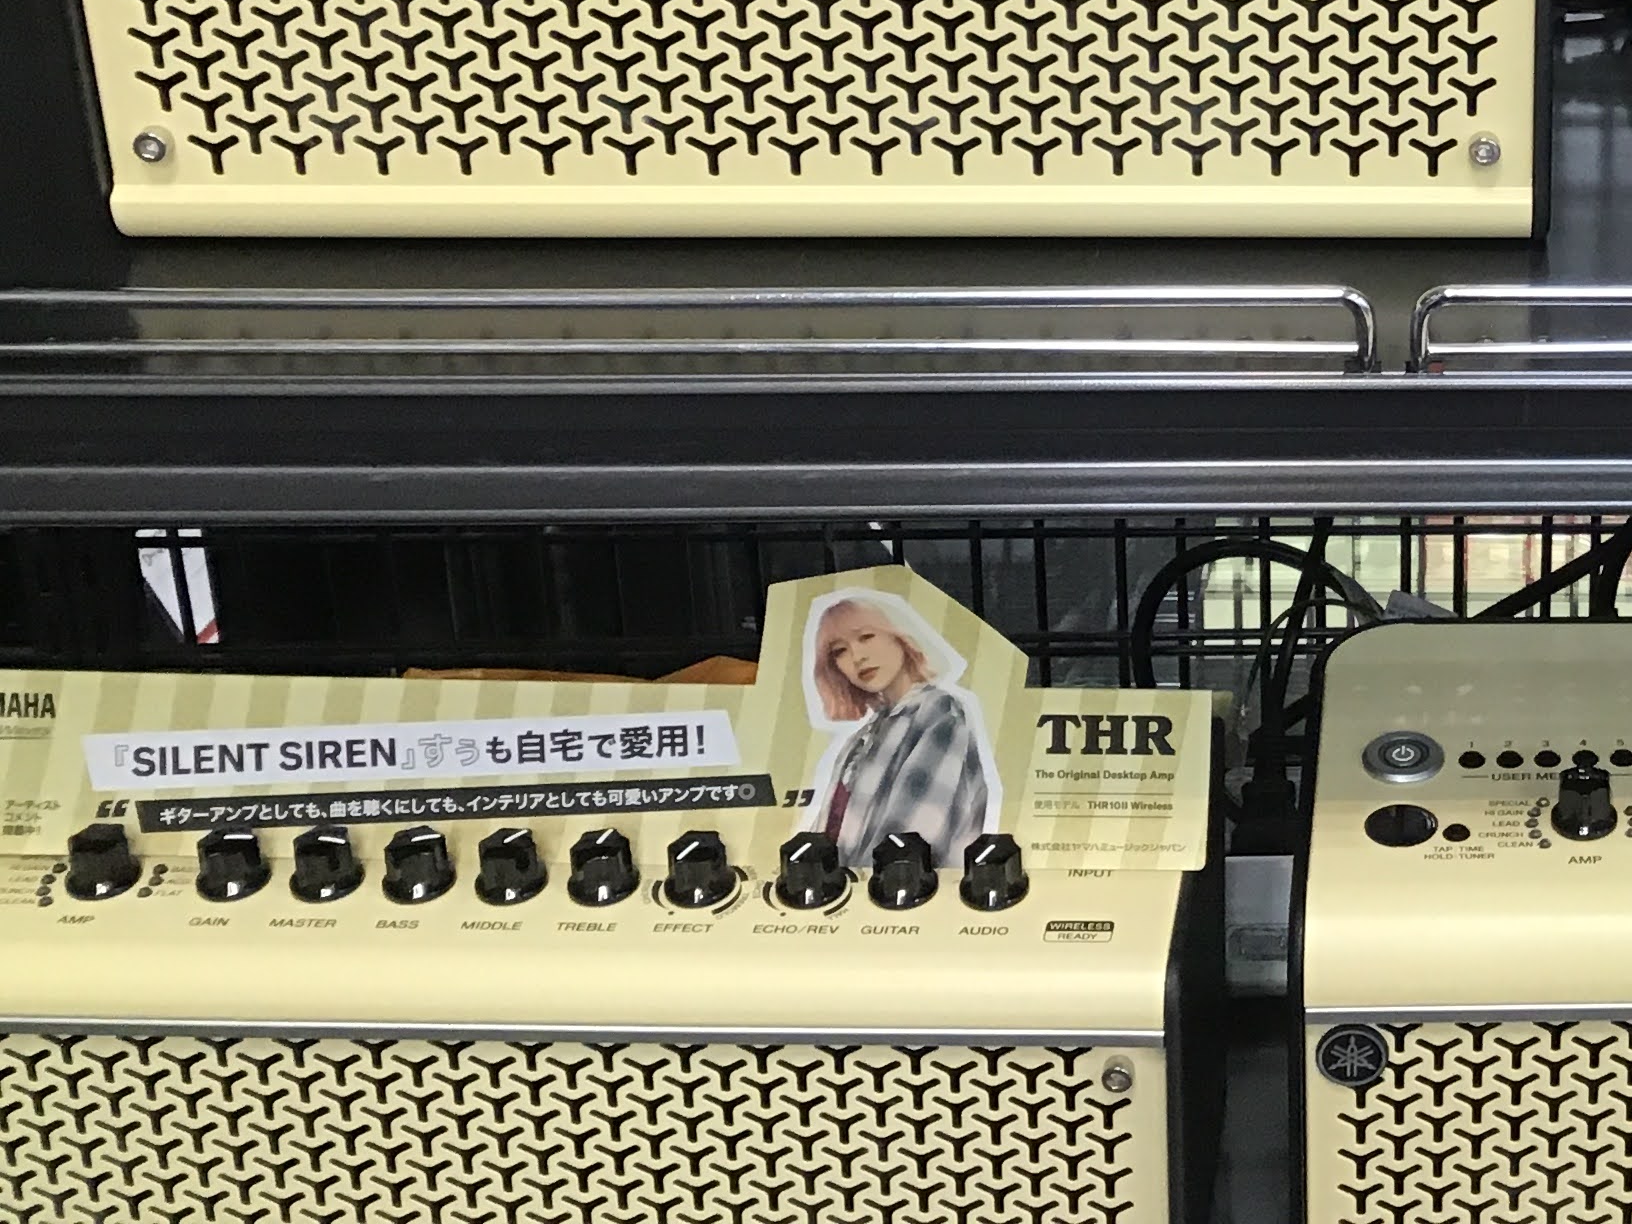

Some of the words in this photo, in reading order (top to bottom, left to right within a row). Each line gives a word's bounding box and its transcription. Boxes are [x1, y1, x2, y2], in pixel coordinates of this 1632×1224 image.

[1036, 714, 1176, 755] THR
[1035, 769, 1055, 779] The
[1057, 769, 1100, 781] Original
[1103, 770, 1147, 782] Desktop
[1150, 771, 1175, 782] Amp
[1491, 773, 1531, 781] USER
[1131, 801, 1173, 811] Wireless
[1568, 856, 1602, 864] AMP
[1068, 869, 1113, 878] INPUT
[57, 915, 96, 925] AMP
[189, 917, 230, 927] GAIN
[268, 918, 338, 928] MASTER
[375, 919, 419, 929] BASS
[460, 921, 523, 931] MIDDLE
[556, 922, 618, 932] TREBLE
[653, 923, 714, 933] EFFECT
[752, 924, 840, 934] ECHO/REV
[860, 925, 920, 935] GUITAR
[958, 925, 1010, 936] AUDIO
[1050, 922, 1112, 931] WIRELESS
[1057, 932, 1098, 940] READY
